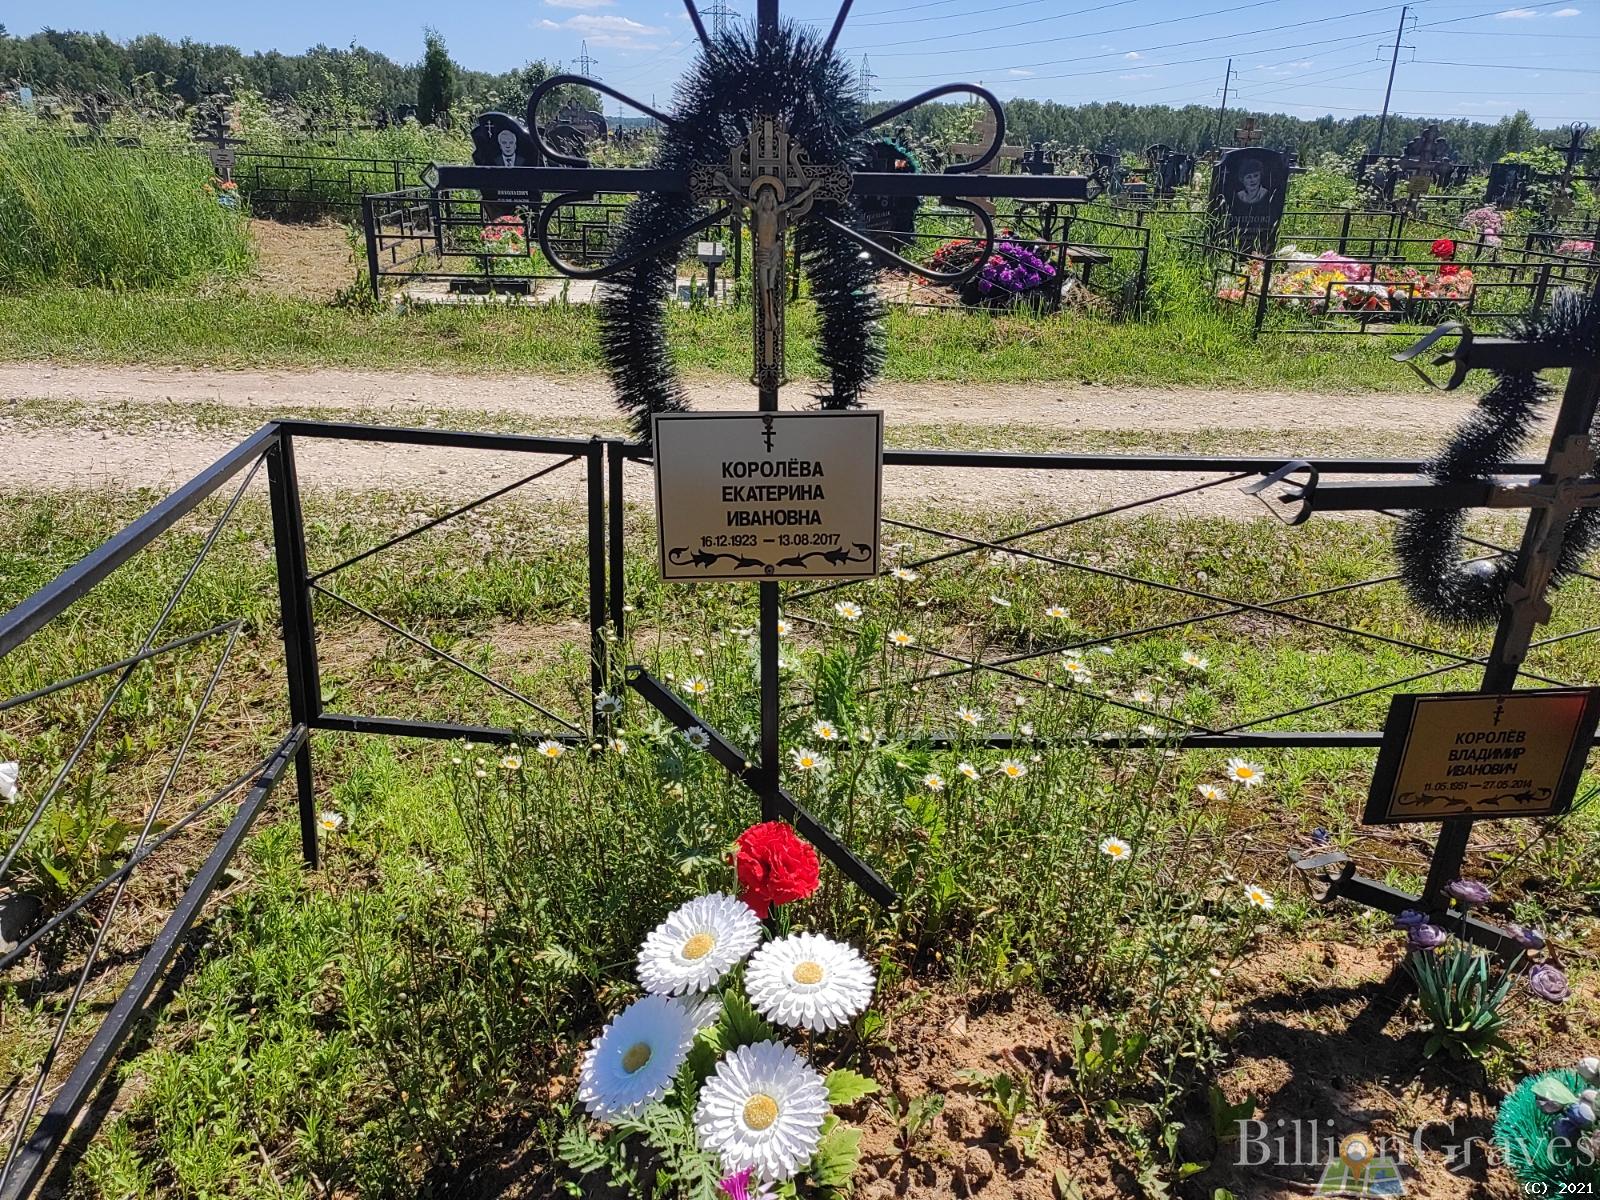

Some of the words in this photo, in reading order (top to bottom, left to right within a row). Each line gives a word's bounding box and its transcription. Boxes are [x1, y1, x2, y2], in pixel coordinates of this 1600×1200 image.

[722, 458, 824, 478] КОРОЛЁВА
[722, 484, 824, 502] ЕКАТЕРИНА
[727, 510, 822, 526] ИВАНОВНА
[701, 534, 758, 547] 16.12.1923
[778, 533, 841, 546] 13.08.2017
[1455, 729, 1526, 745] КОРОЛЁВ
[1448, 747, 1526, 762] ВЛАДИМИР
[1446, 763, 1518, 777] ИВАНОВИЧ
